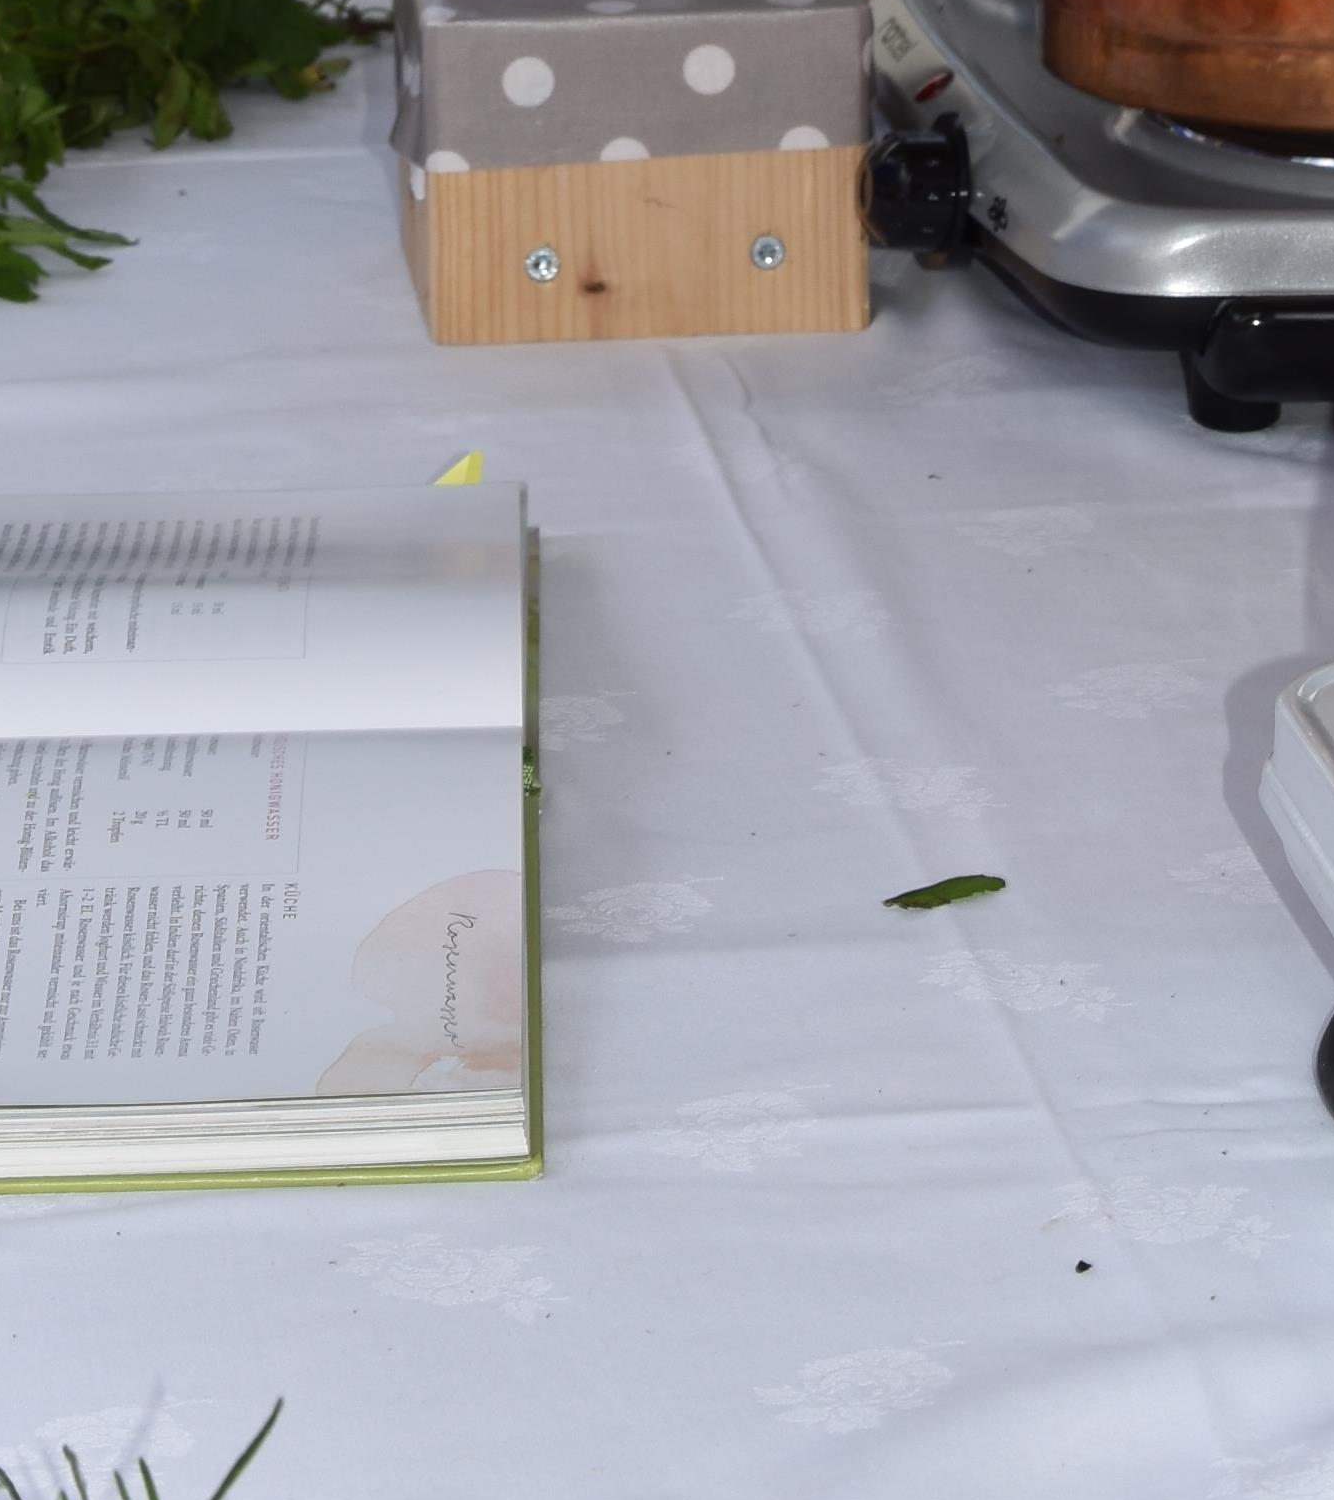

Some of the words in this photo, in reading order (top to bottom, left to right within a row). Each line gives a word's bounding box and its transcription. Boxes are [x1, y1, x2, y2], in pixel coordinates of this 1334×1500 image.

[82, 888, 95, 902] 1–2
[104, 887, 117, 907] tränk
[149, 886, 159, 910] wasser
[194, 885, 207, 908] richte,
[282, 882, 301, 920] KÜCHE
[440, 912, 478, 1049] Rosenwasser
